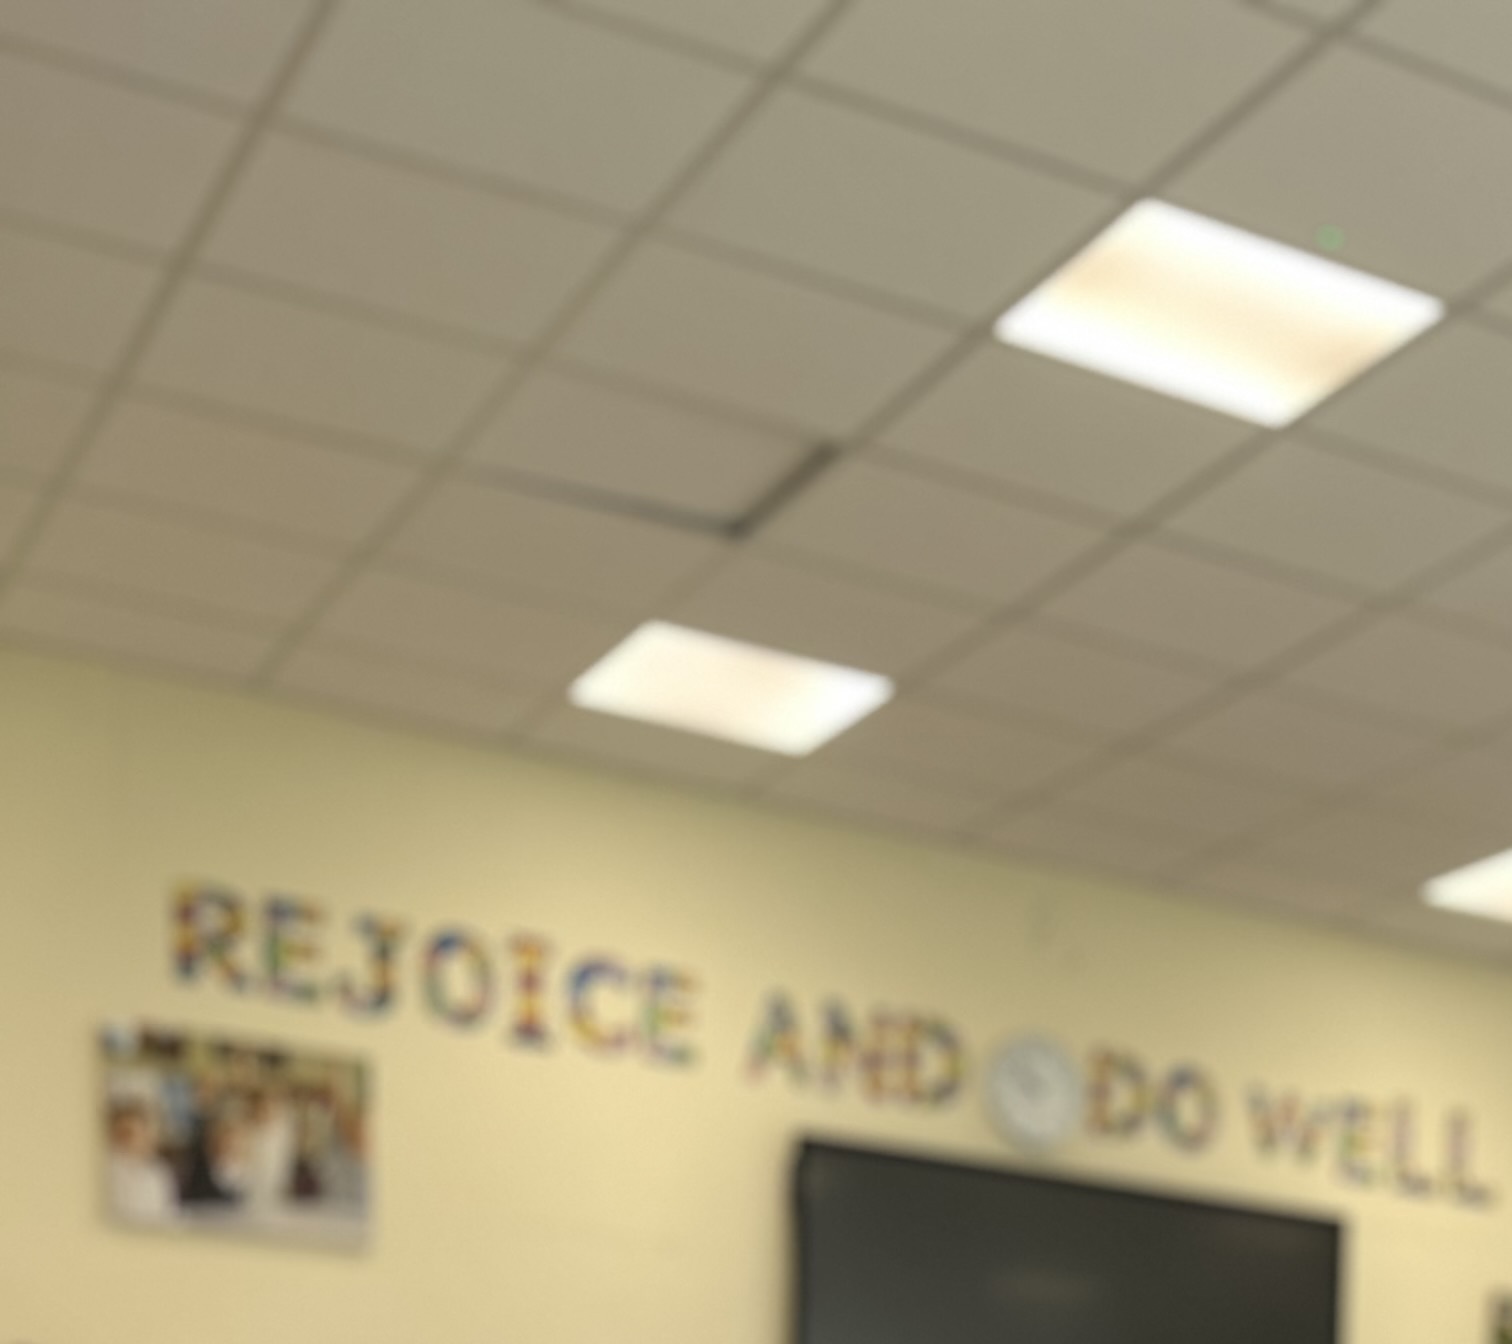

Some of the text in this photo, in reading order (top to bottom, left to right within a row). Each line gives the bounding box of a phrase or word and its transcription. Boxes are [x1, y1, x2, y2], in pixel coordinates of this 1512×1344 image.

[170, 880, 1500, 1207] REJOICE AND DO WELL
